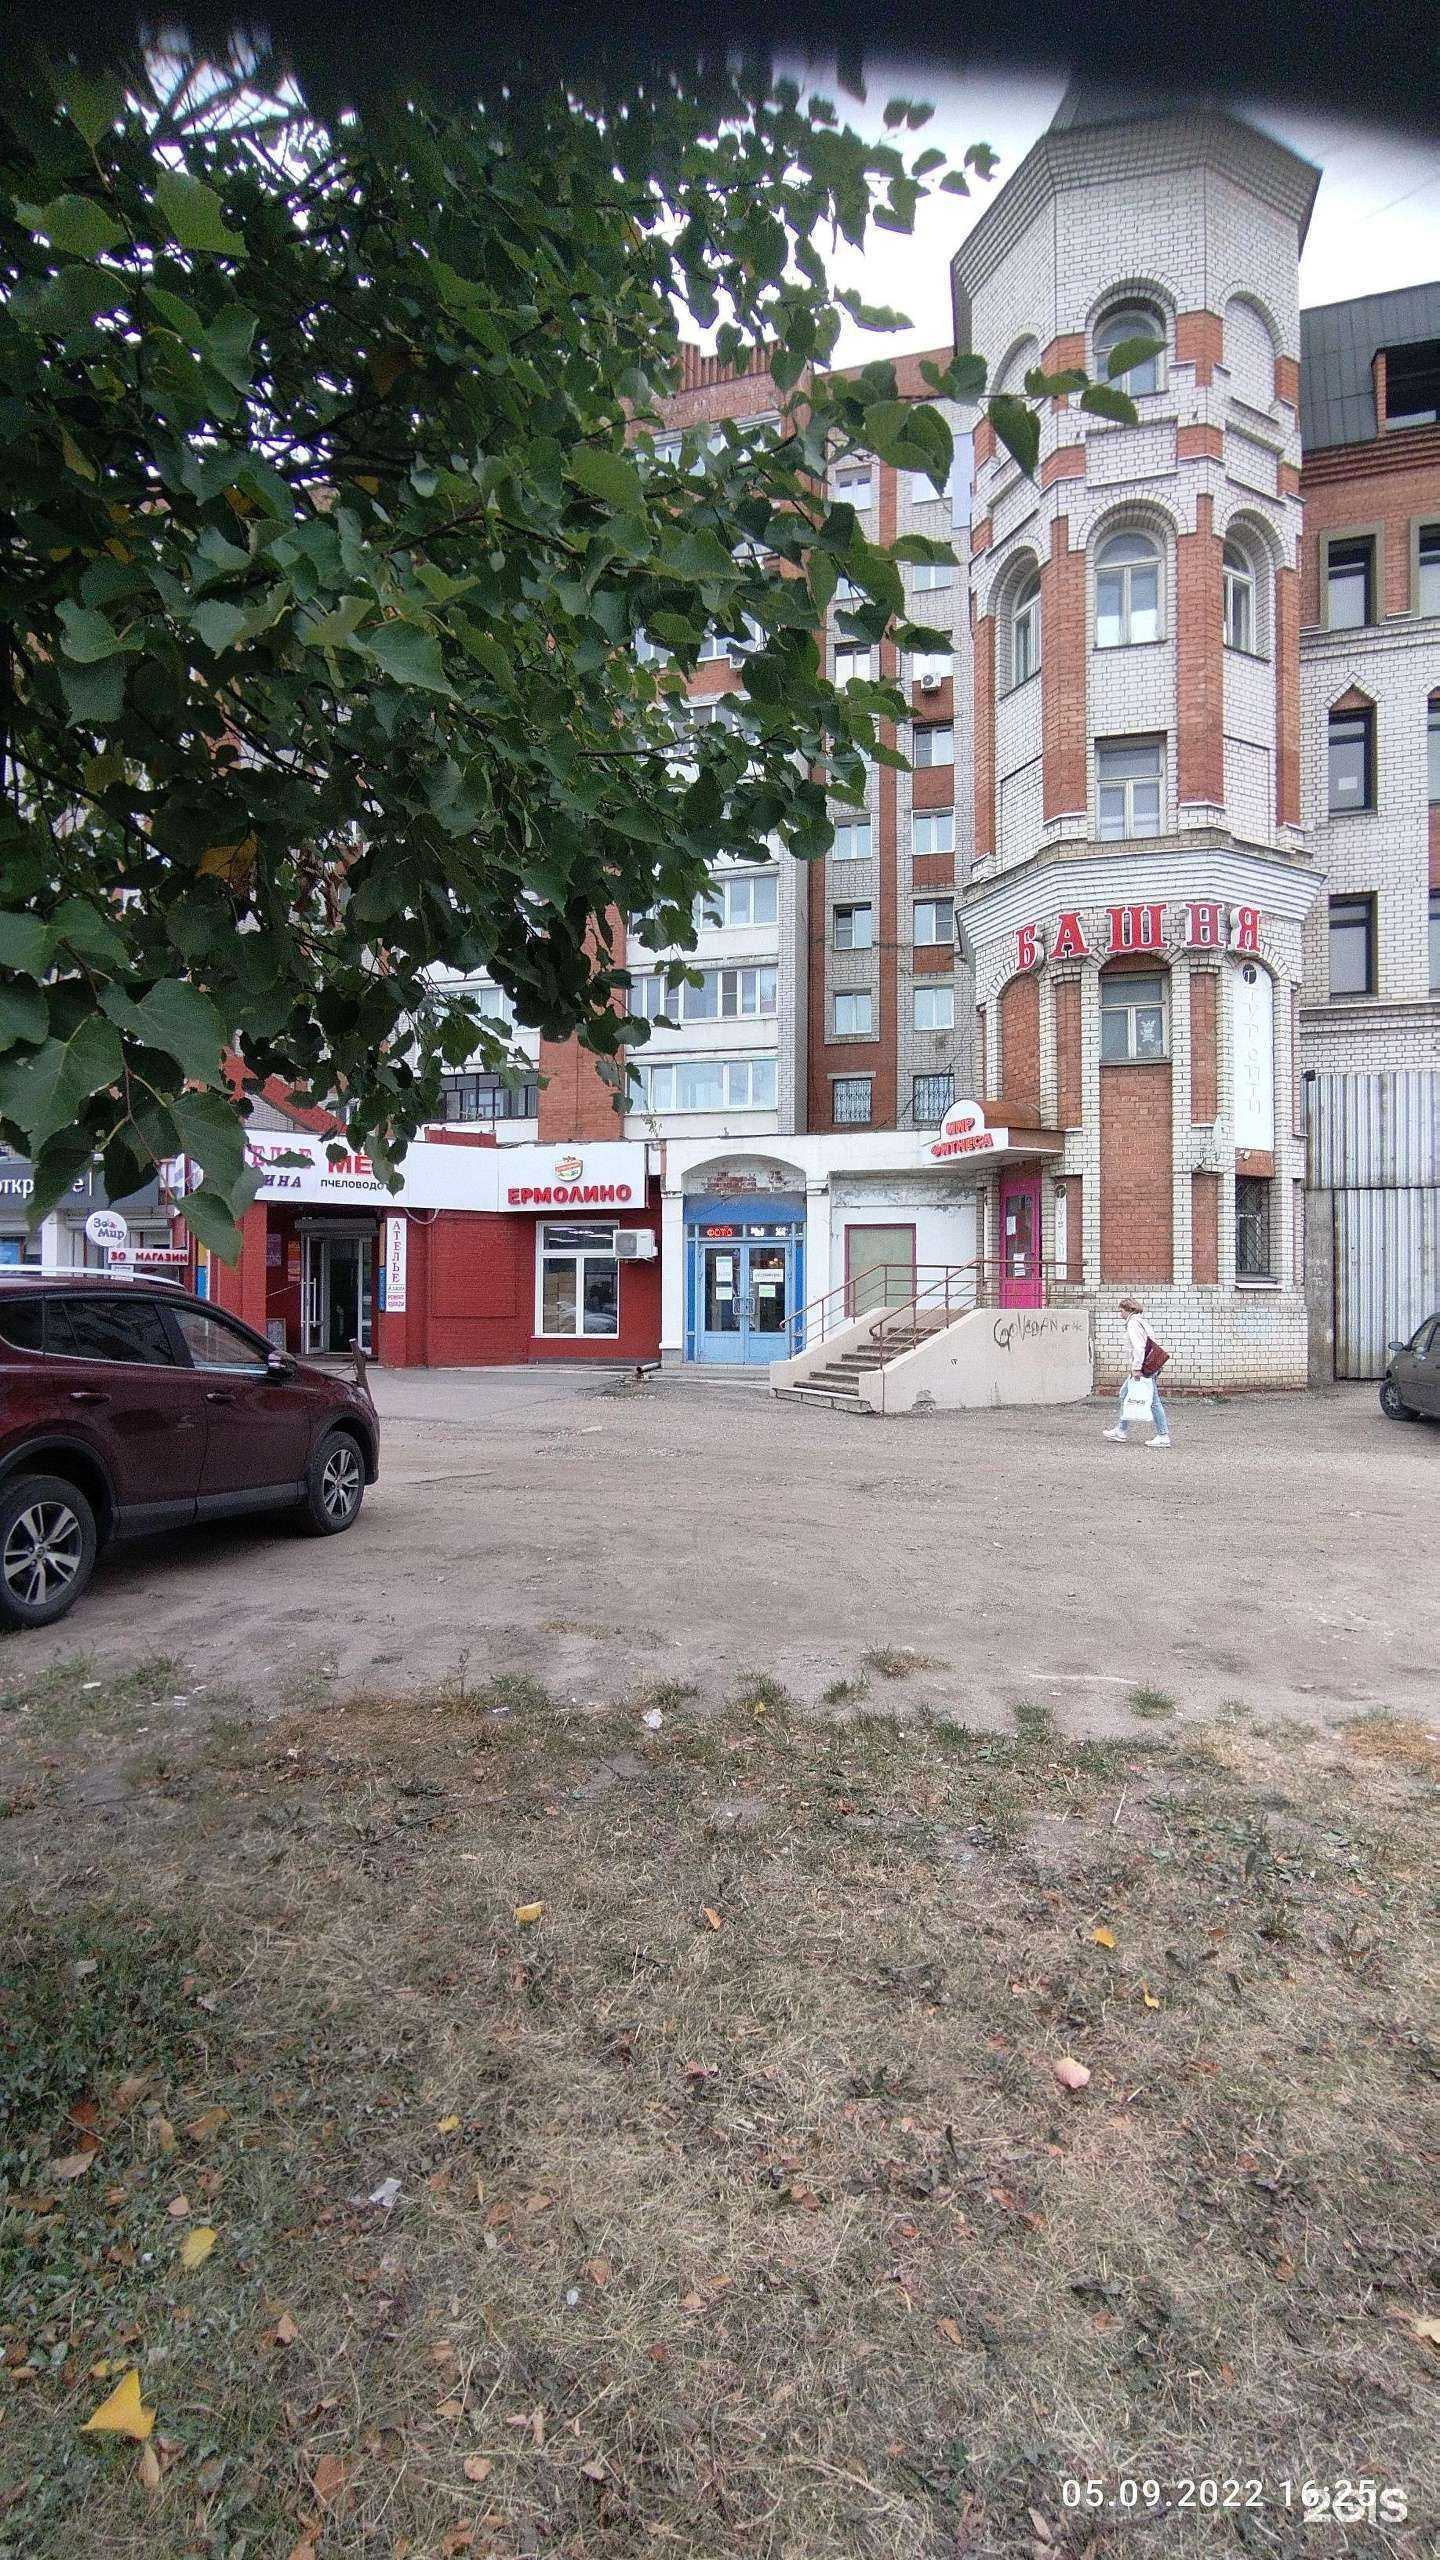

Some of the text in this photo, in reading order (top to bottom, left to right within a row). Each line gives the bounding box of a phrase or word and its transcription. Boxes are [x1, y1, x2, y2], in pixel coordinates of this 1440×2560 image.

[1015, 904, 1262, 972] БАШНЯ
[508, 1184, 632, 1205] ЕРМОЛИНО
[97, 1228, 125, 1240] Мир
[135, 1252, 188, 1262] МАГАЗИН
[392, 1221, 402, 1283] АТЕЛЬЕ
